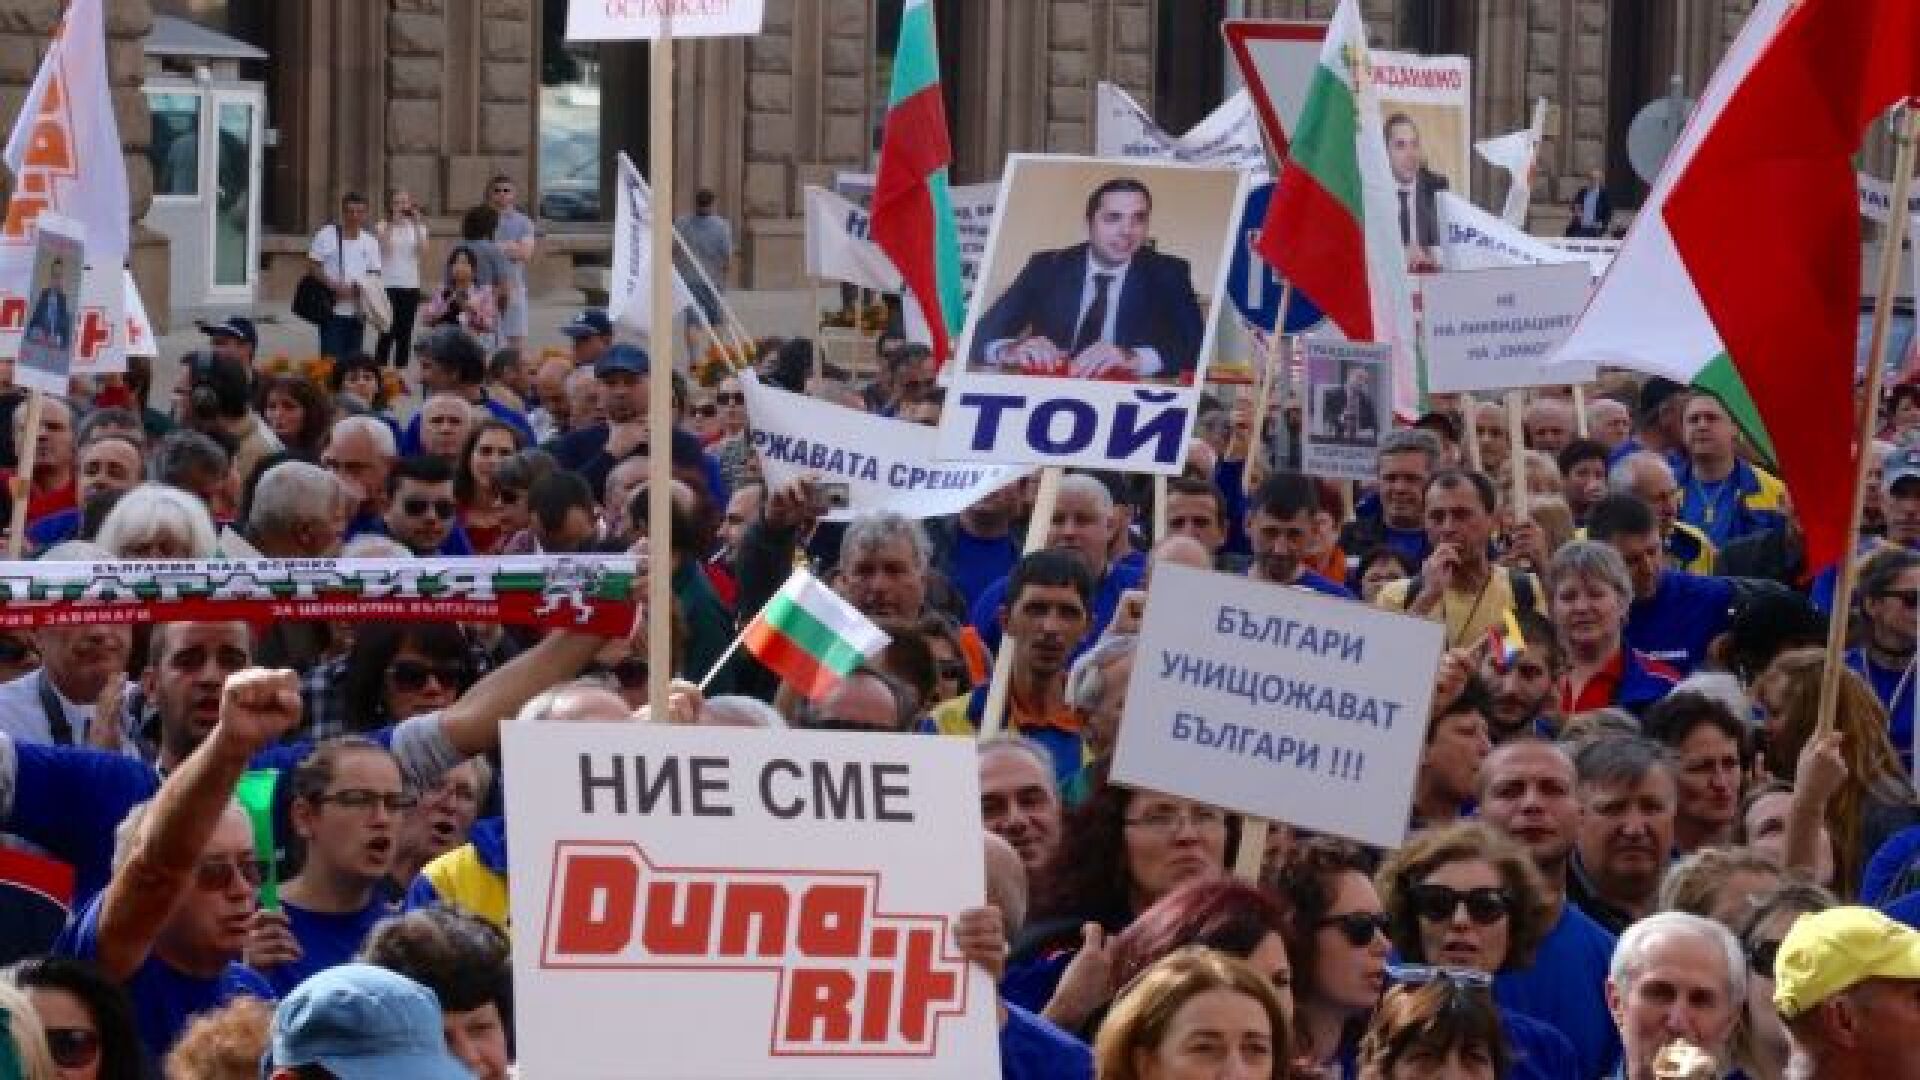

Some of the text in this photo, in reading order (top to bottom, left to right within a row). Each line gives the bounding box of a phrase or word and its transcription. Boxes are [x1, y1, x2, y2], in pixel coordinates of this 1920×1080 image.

[960, 389, 1189, 465] ТОЙ
[1216, 605, 1365, 664] БЪЛГАРИ
[1160, 649, 1402, 730] УНИЩОЖАВАТ
[1171, 710, 1365, 781] БЪЛГАРИ !!!
[579, 753, 915, 823] НИЕ СМЕ
[555, 854, 867, 958] Duna
[784, 928, 956, 1042] Rit
